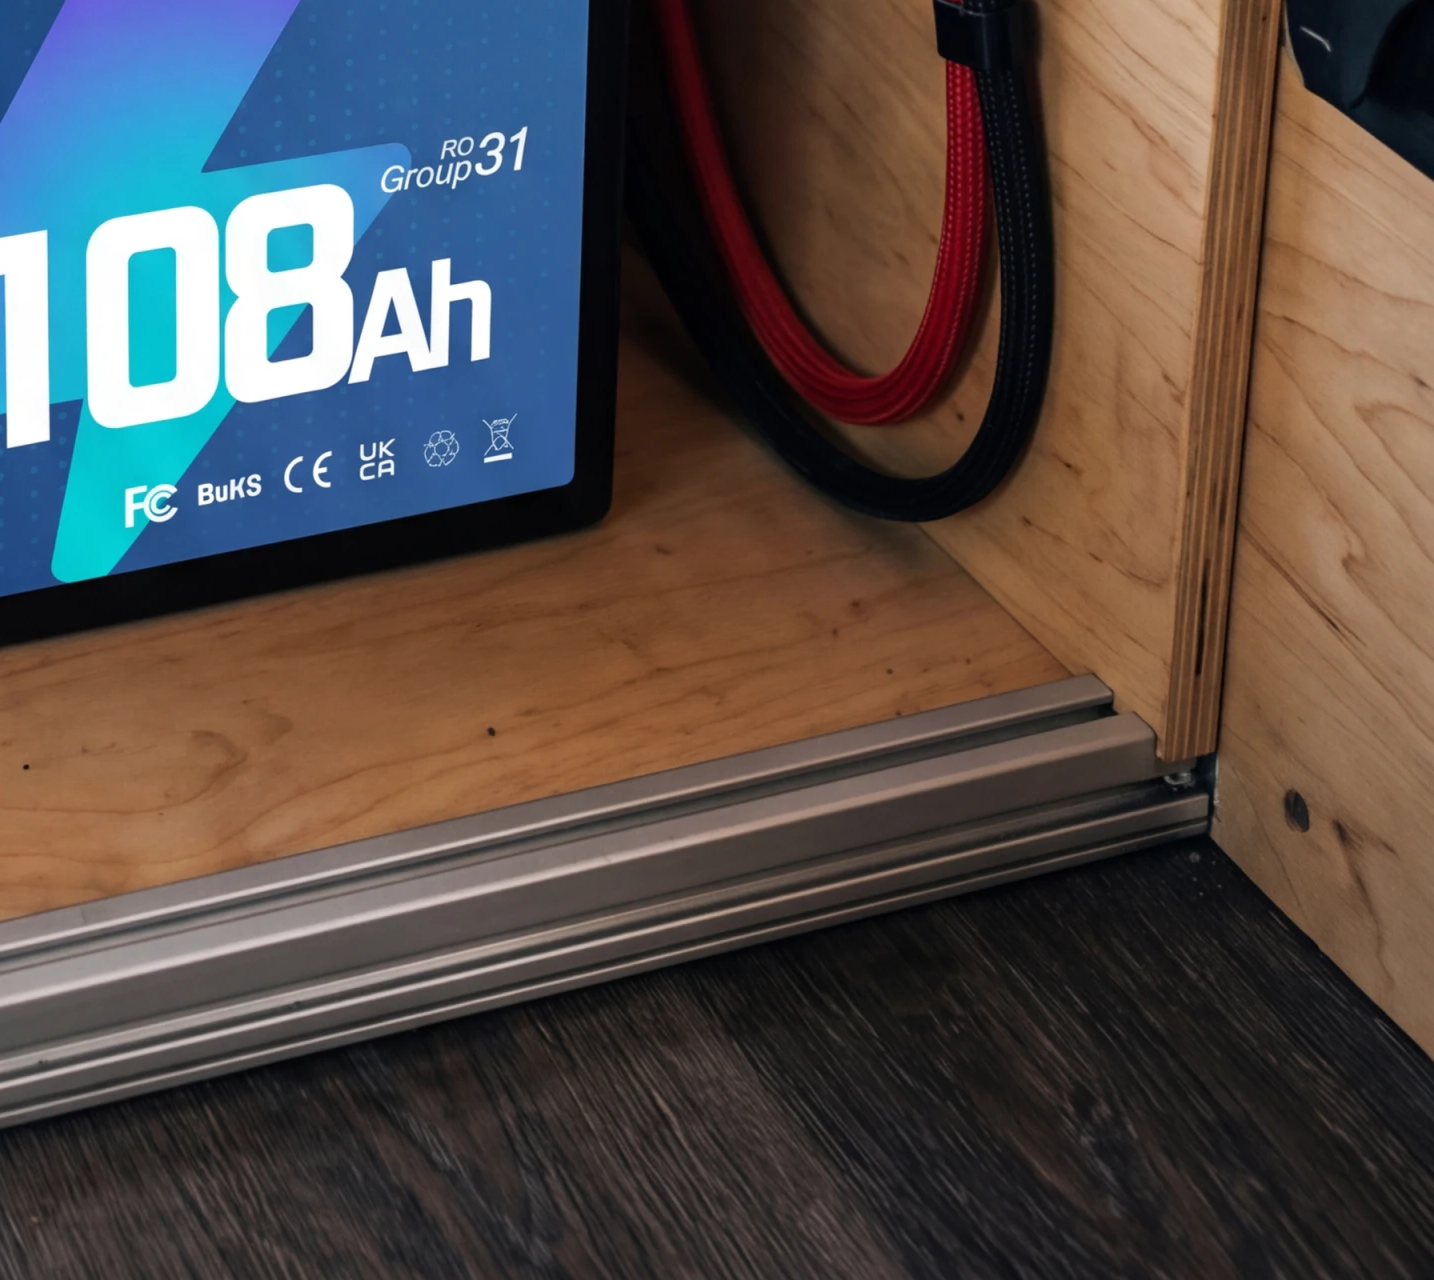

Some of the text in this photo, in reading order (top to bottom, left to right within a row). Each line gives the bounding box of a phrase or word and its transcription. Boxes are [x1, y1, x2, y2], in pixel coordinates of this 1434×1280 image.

[380, 126, 528, 194] Group 31
[440, 136, 474, 160] RO
[359, 438, 396, 461] UK
[283, 451, 333, 493] CE
[359, 459, 396, 481] CA
[197, 474, 262, 506] BuKS
